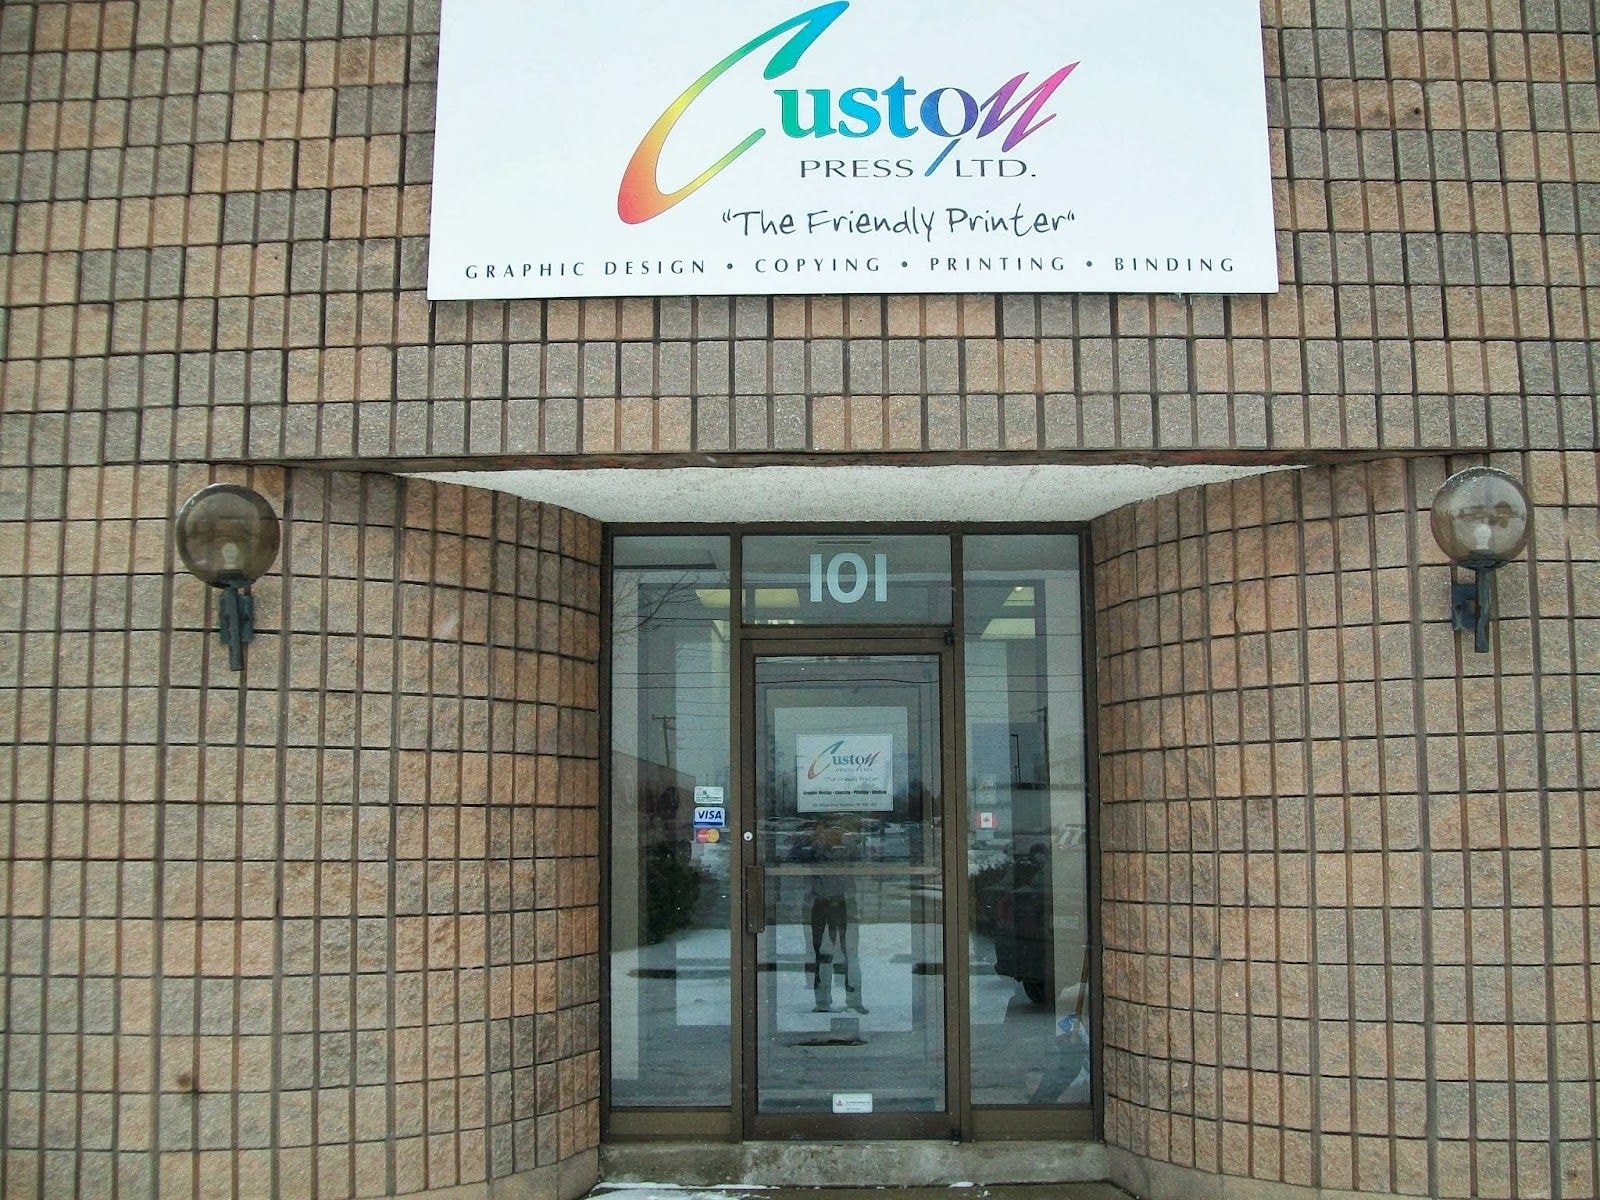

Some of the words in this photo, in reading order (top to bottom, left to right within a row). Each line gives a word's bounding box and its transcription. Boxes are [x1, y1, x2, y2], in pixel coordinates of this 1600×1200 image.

[617, 1, 1079, 225] Custom
[800, 159, 914, 178] PRESS
[955, 159, 1037, 177] LTD.
[806, 205, 935, 242] Friendly
[465, 262, 585, 279] GRAPHIC
[604, 259, 706, 275] DESIGN
[755, 258, 881, 273] COPYING
[930, 257, 1065, 272] PRINTING
[1114, 257, 1234, 272] BINDING
[809, 552, 887, 604] 101
[808, 740, 880, 779] Custom
[698, 810, 722, 820] VISA
